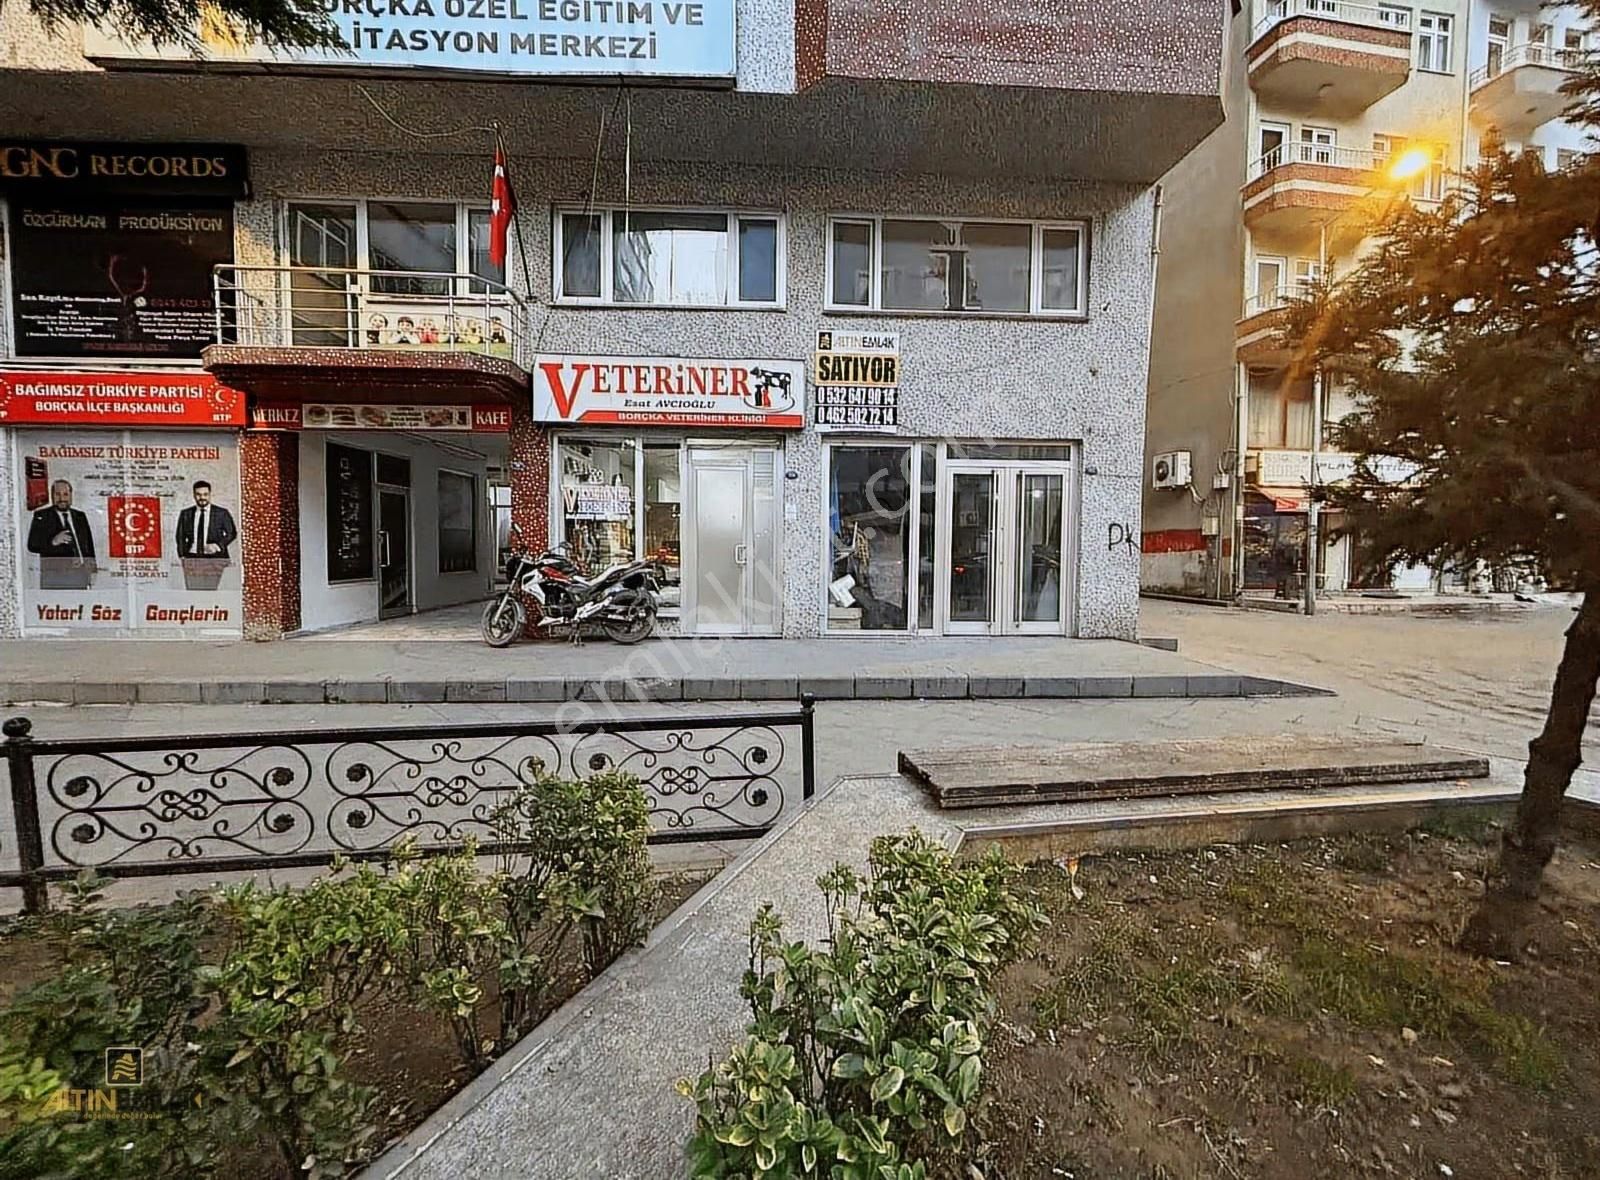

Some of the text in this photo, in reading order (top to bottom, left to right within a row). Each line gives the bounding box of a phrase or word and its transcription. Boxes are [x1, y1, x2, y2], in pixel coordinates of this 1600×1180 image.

[662, 3, 703, 25] VE
[510, 32, 657, 59] MERKEZİ
[0, 147, 227, 178] GNC RECORDS
[818, 355, 895, 383] SATIYOR
[15, 382, 203, 399] BAĞIMSIZ TÜRKİYE PARTİSİ
[826, 387, 847, 405] 532
[35, 399, 185, 414] BORÇKA İLÇE BAŞKANLIĞI
[624, 399, 650, 408] Esat
[252, 408, 508, 425] MERKEZ KAFE
[826, 406, 846, 424] 462
[847, 407, 868, 425] 502
[882, 408, 894, 425] 14
[107, 445, 168, 460] TÜRKİYE
[170, 446, 220, 460] PARTİSİ
[91, 604, 122, 622] Söz
